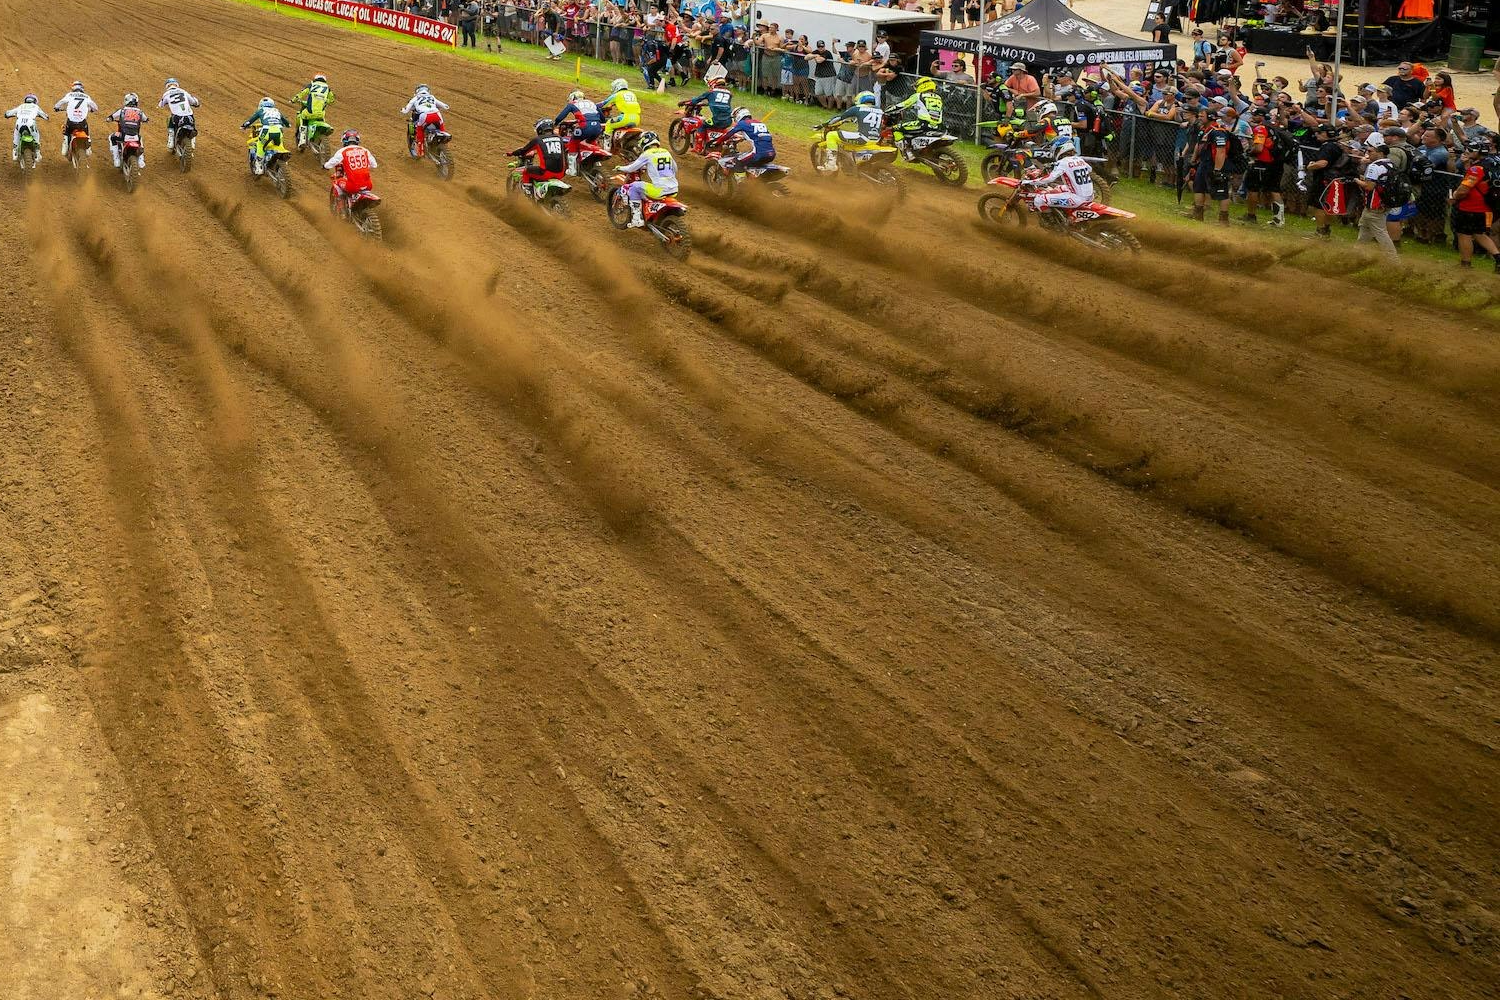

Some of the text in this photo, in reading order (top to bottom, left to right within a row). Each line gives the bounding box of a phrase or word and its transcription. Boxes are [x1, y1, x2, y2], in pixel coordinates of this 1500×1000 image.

[324, 1, 334, 13] OIL
[337, 3, 370, 21] LUCAS OIL
[373, 11, 410, 31] LUCAS OIL
[413, 20, 439, 39] LUCAS
[933, 36, 969, 49] SUPPORT
[1001, 45, 1036, 62] MOTO
[74, 98, 85, 110] 7
[169, 92, 186, 105] 3
[715, 93, 730, 104] 92
[863, 113, 883, 129] 41
